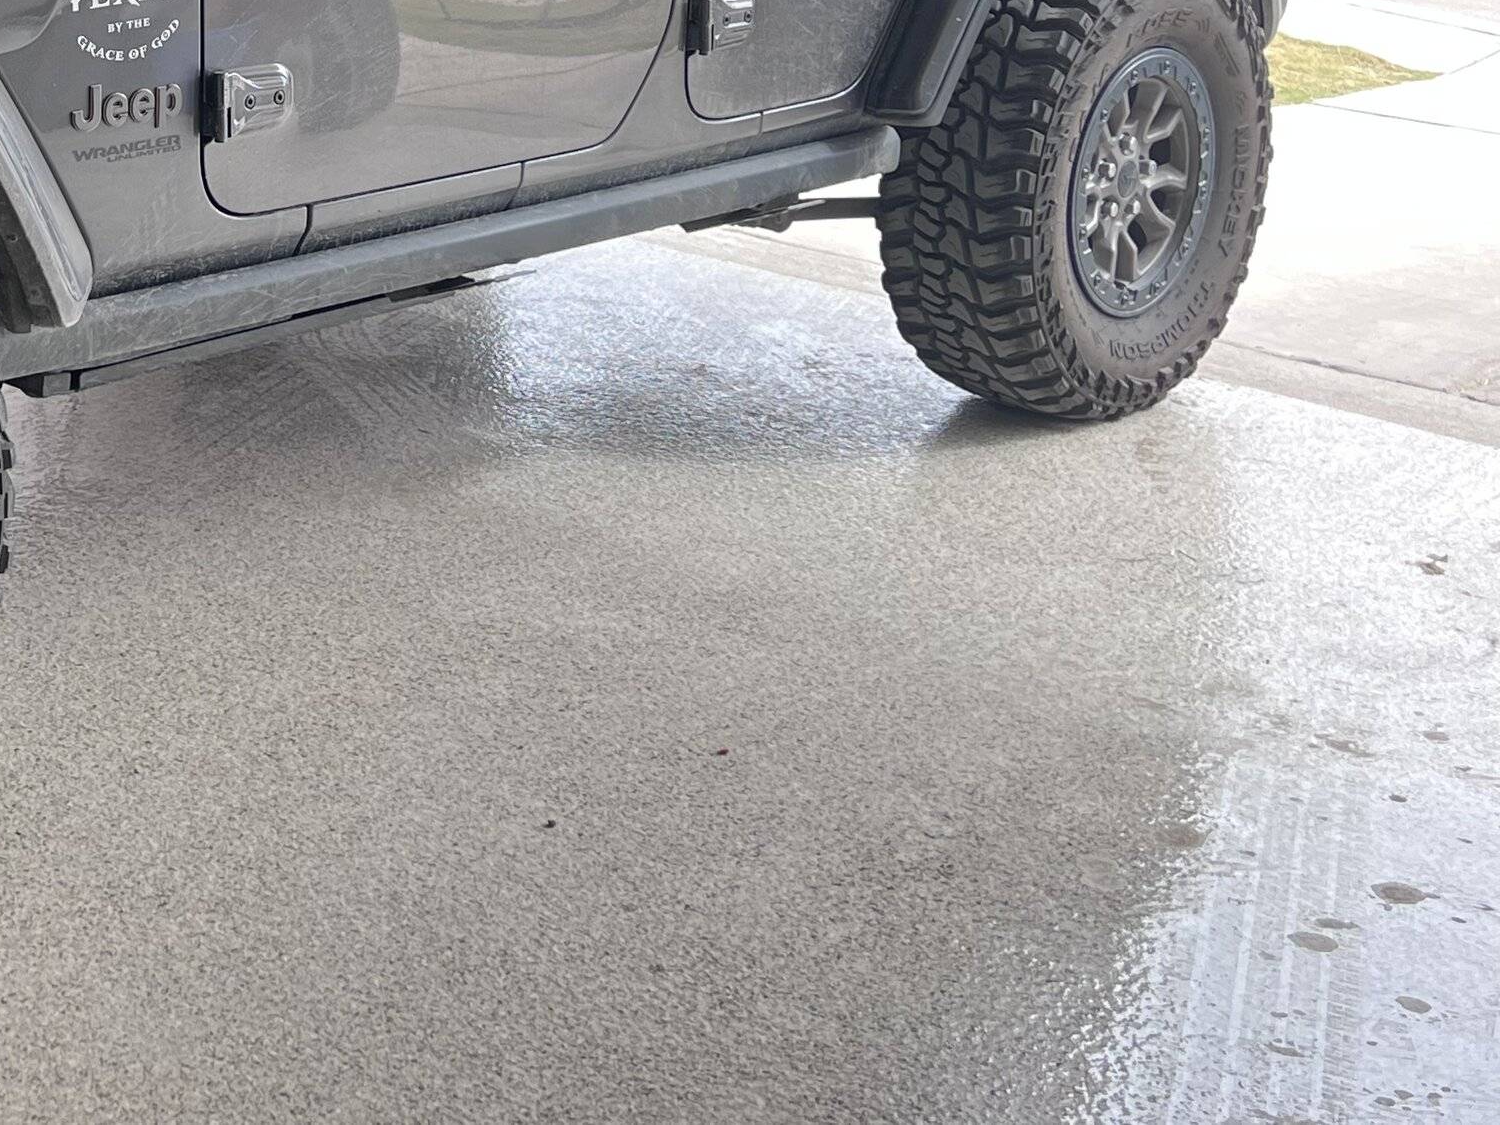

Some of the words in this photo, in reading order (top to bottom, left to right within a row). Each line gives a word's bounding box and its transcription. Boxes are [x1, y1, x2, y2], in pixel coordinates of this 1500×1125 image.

[107, 22, 124, 33] BY
[126, 17, 151, 31] THE
[77, 35, 125, 61] GRACE
[128, 44, 149, 60] OF
[151, 19, 180, 50] GOD
[70, 83, 183, 132] Jeep
[72, 135, 180, 162] WRANGLER
[107, 145, 182, 163] UNLIMITED
